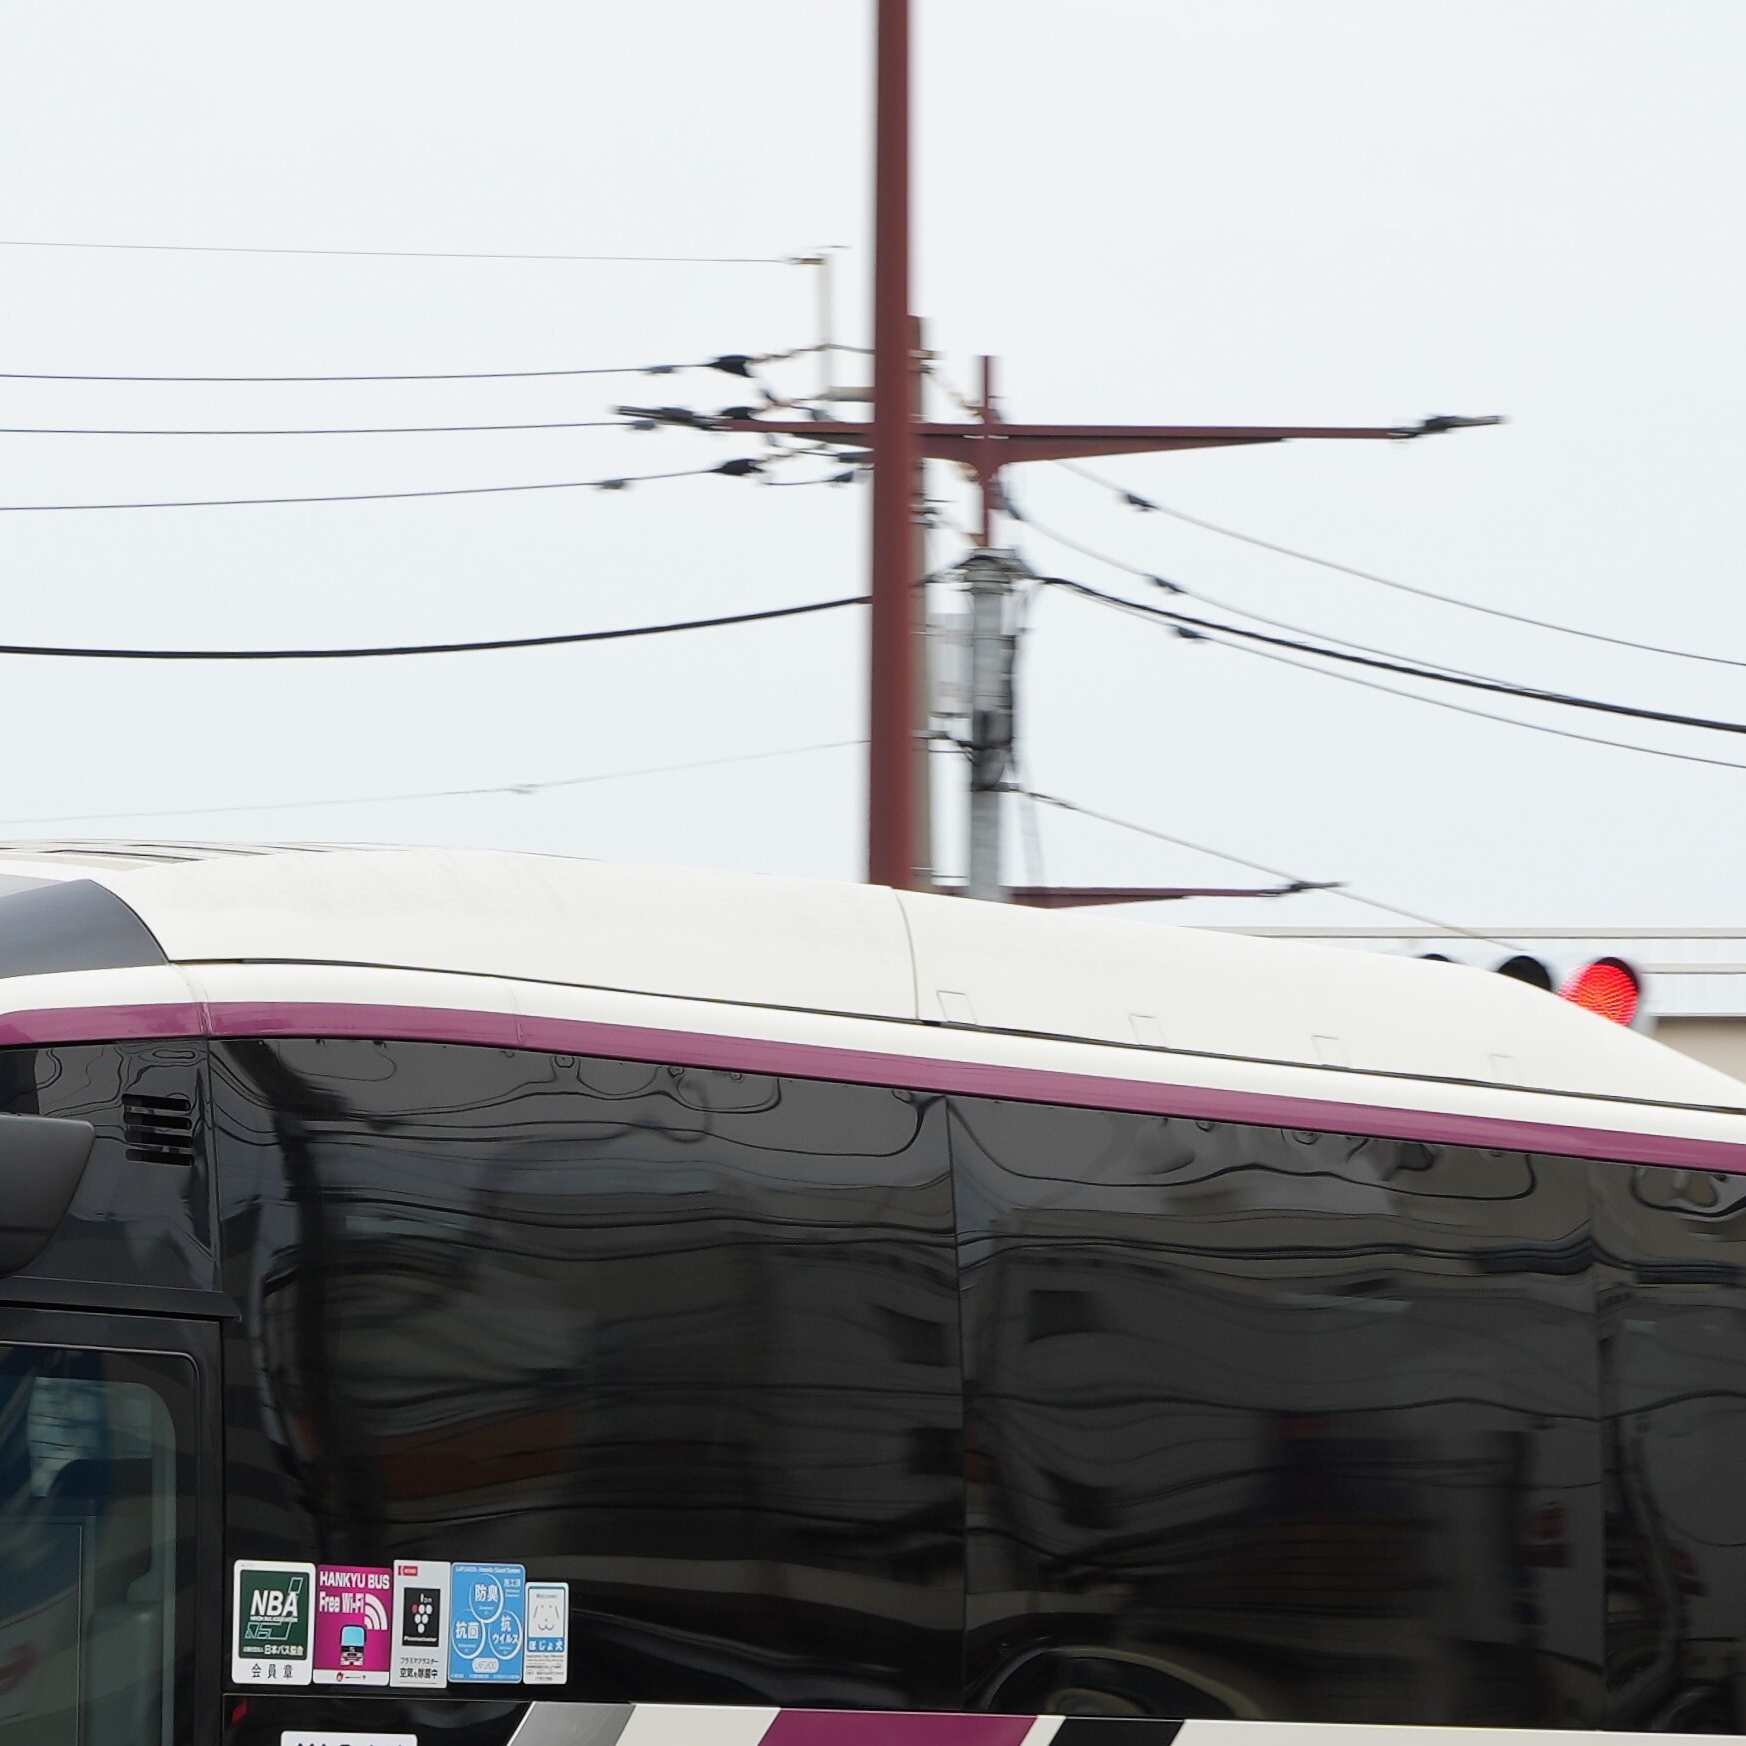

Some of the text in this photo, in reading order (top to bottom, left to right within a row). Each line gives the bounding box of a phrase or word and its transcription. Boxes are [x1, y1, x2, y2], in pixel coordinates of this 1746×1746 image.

[319, 1571, 390, 1590] HANKYU BUS
[474, 1584, 499, 1602] 防臭
[250, 1589, 299, 1617] NBA
[319, 1591, 365, 1614] Free Wi-Fi
[455, 1621, 480, 1639] 抗菌
[500, 1615, 512, 1631] 抗
[491, 1633, 520, 1646] ウイルス
[528, 1639, 564, 1651] ほじょ犬
[251, 1663, 294, 1679] 会員章
